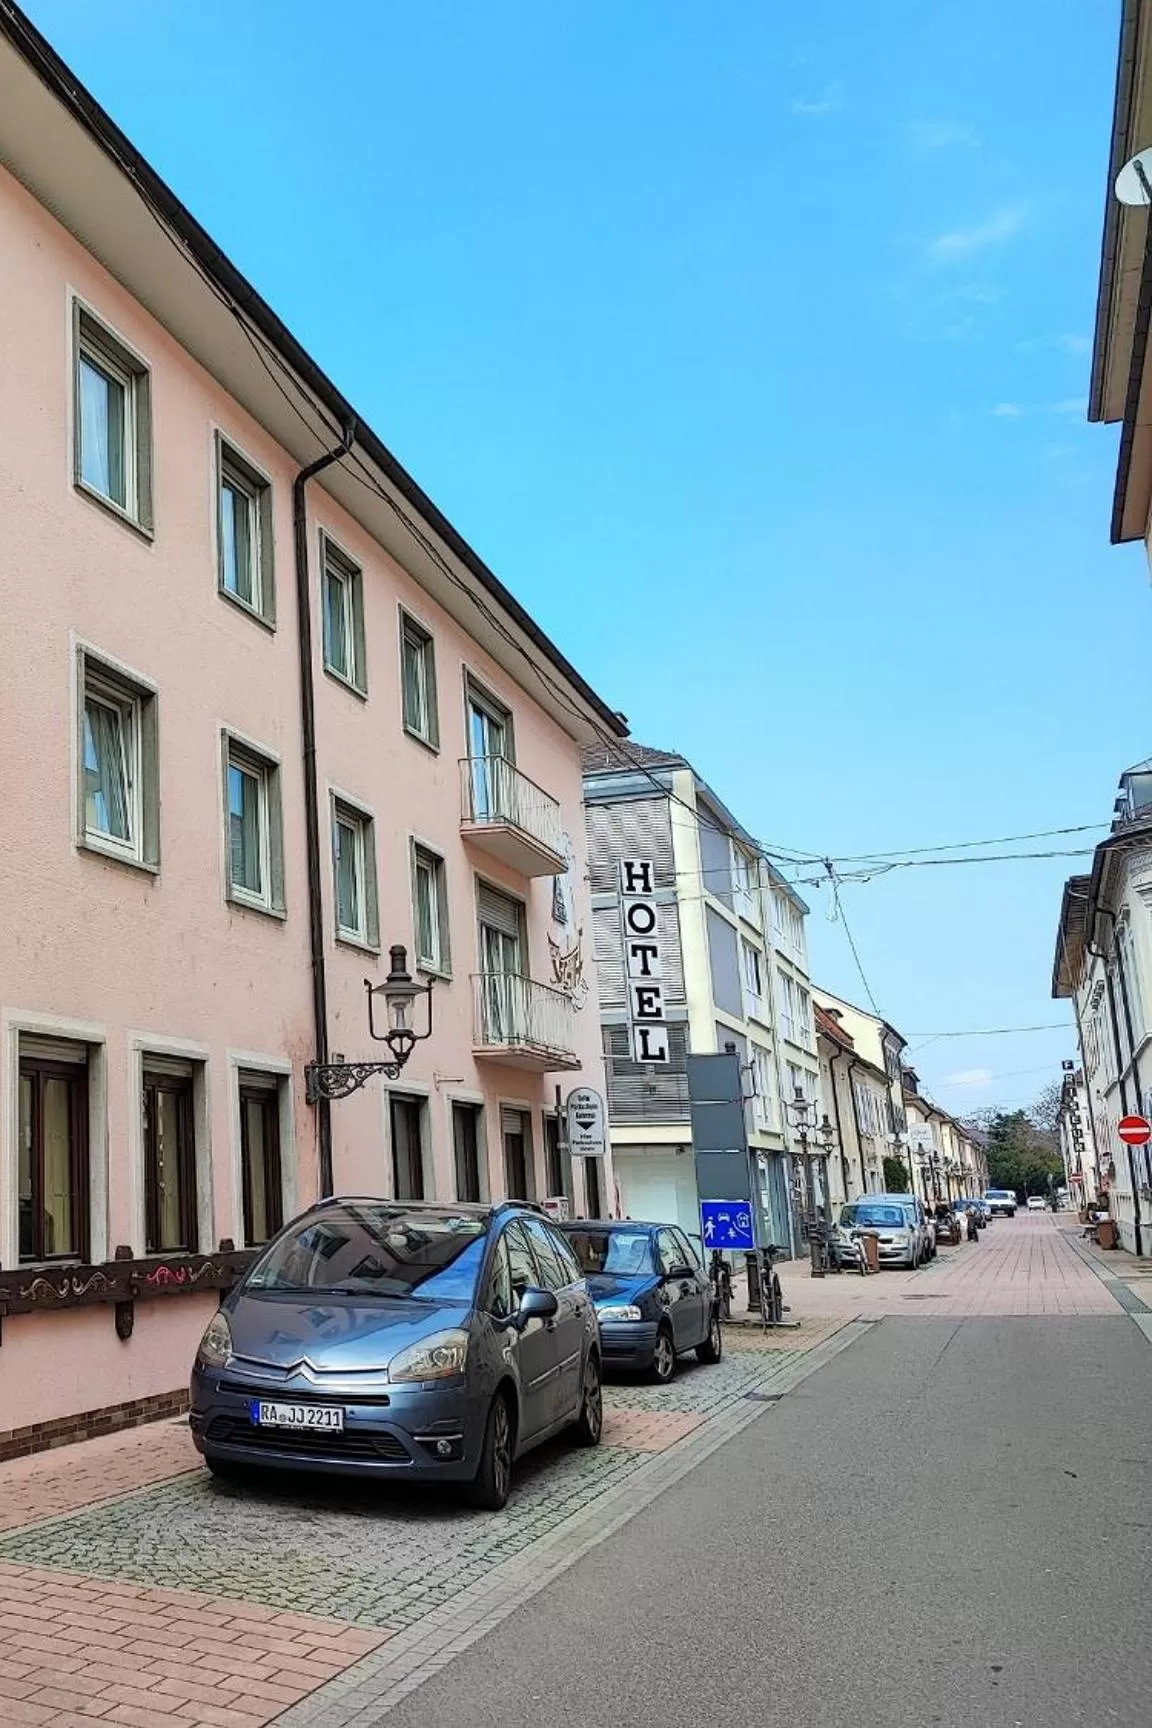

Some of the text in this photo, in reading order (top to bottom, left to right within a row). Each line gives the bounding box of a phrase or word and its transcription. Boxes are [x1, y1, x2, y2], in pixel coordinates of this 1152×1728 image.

[623, 861, 667, 1062] HOTEL
[260, 1404, 341, 1427] RA JJ 2211
